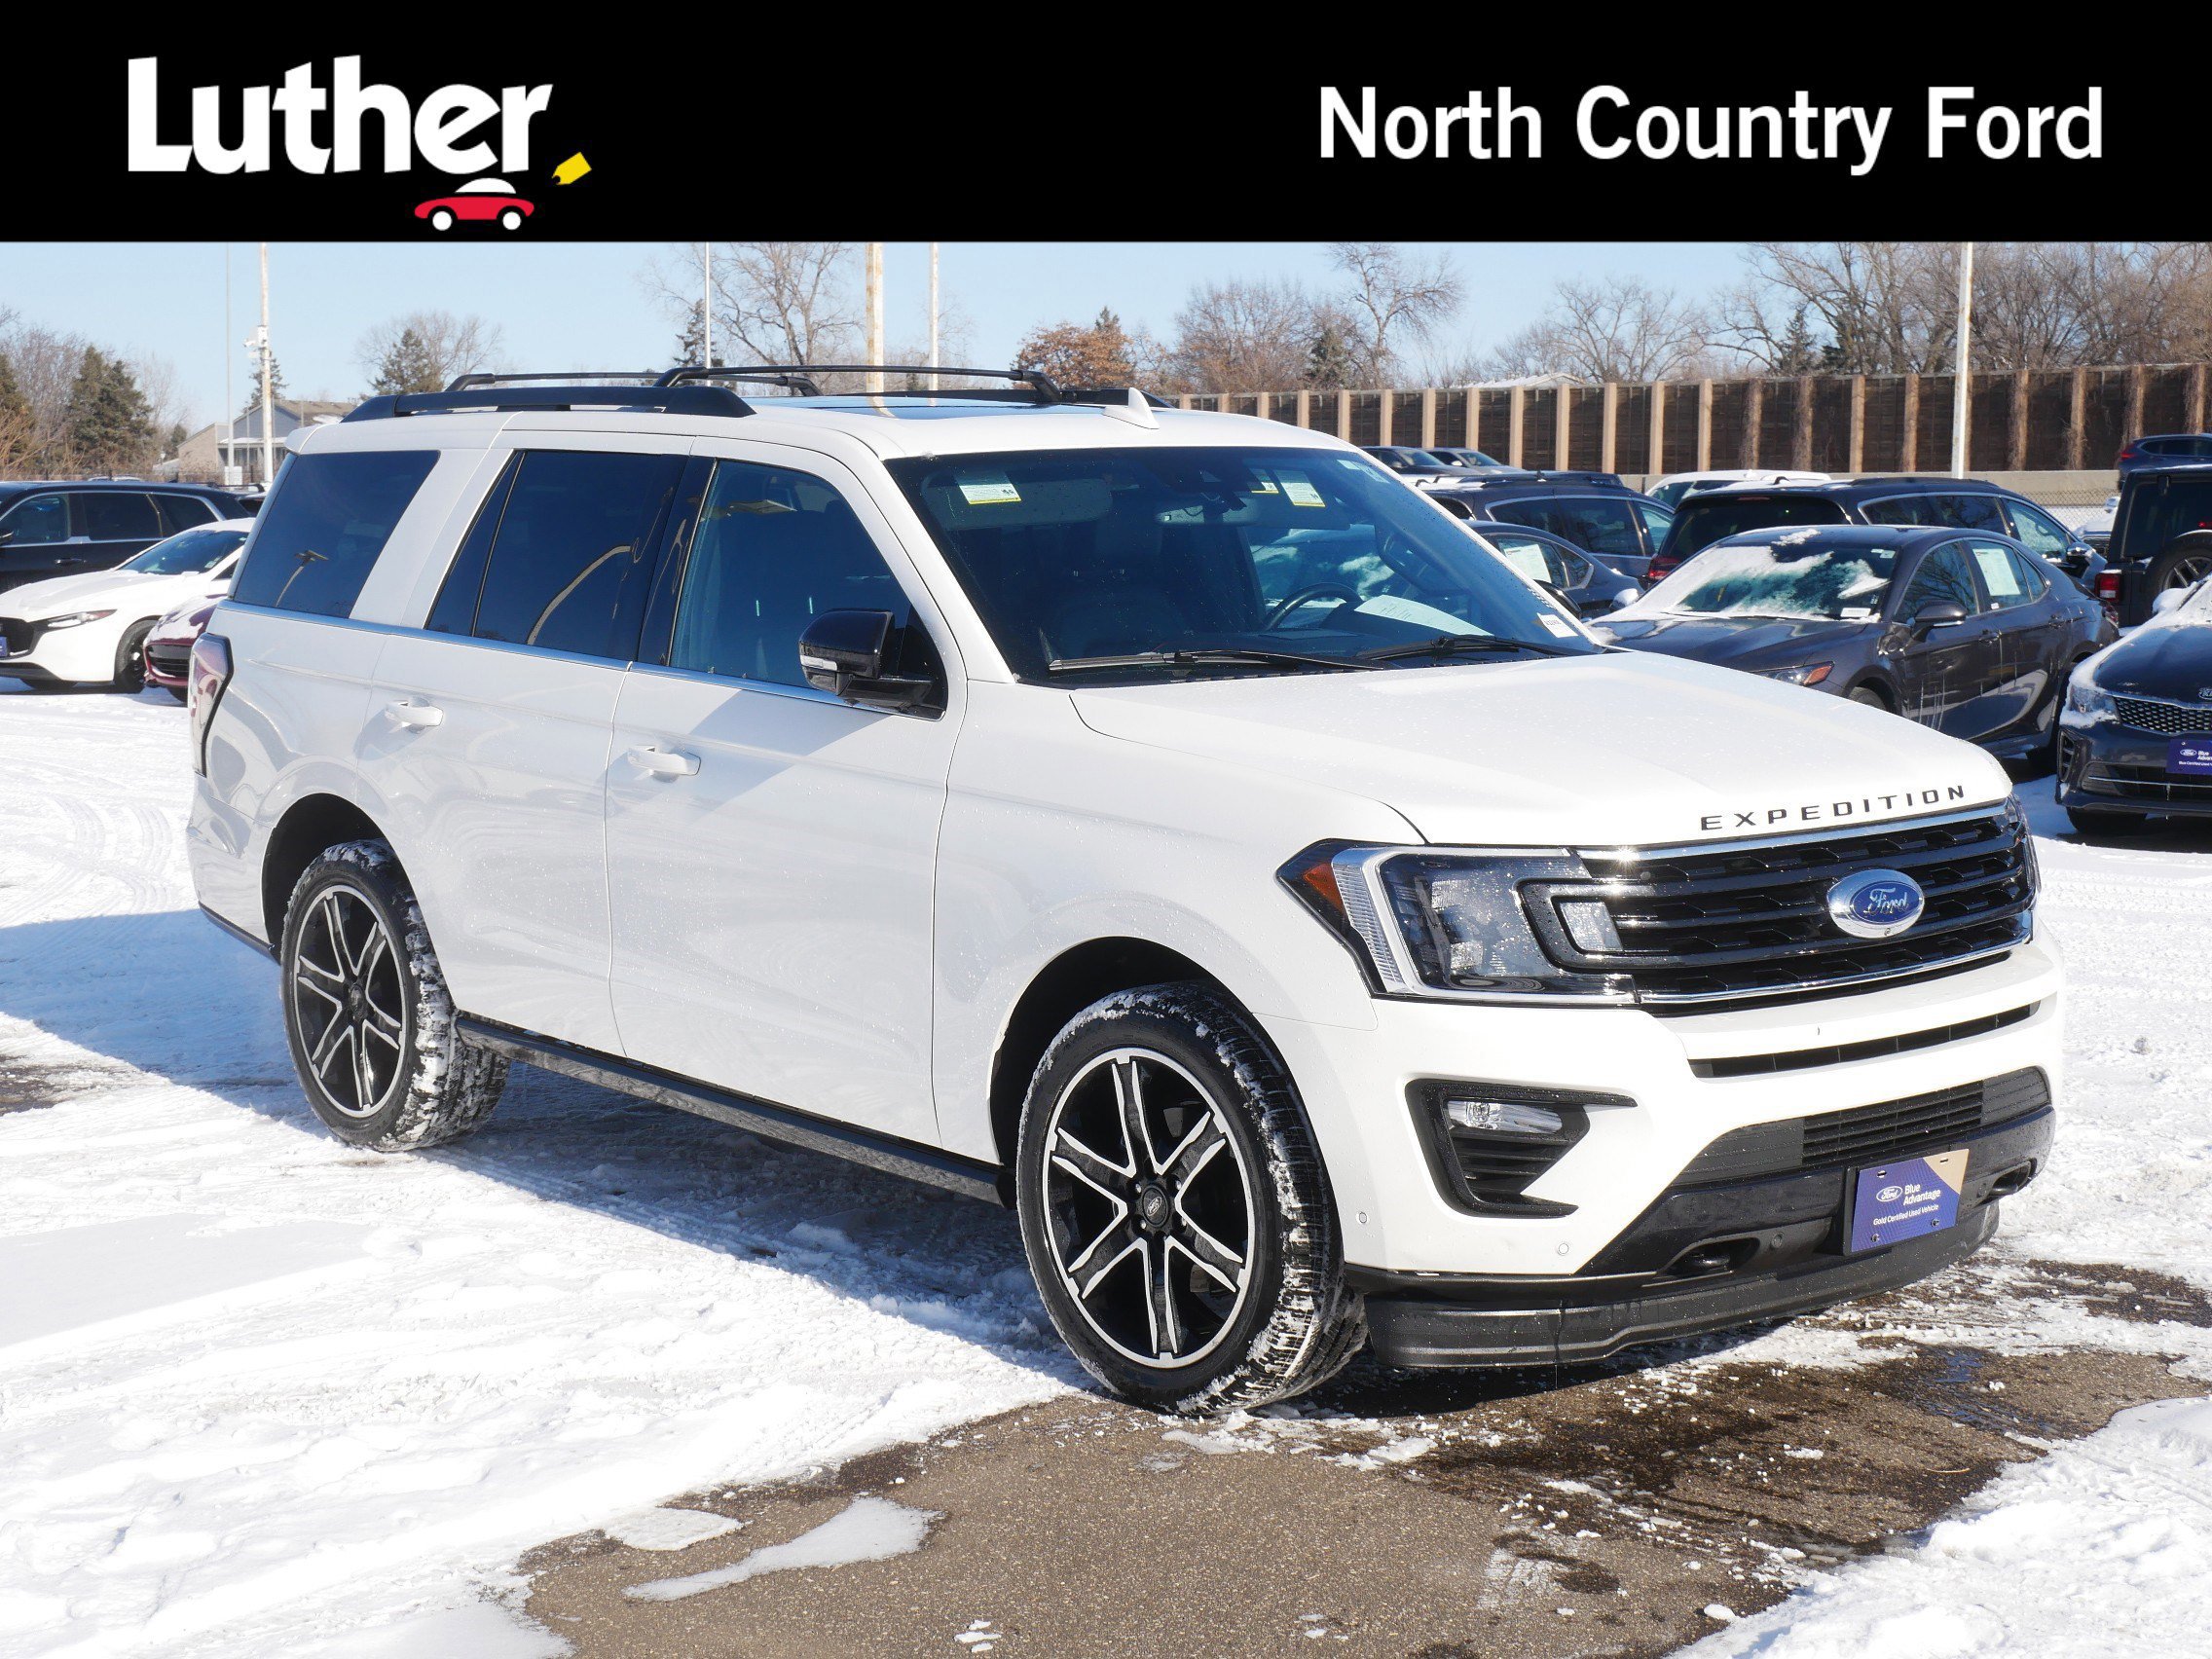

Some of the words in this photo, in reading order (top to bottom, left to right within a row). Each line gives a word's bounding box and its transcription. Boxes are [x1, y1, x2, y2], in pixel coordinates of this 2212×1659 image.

[1701, 786, 1965, 831] EXPEDITION
[1863, 887, 1908, 914] Ford
[1881, 1189, 1899, 1200] Ford
[1902, 1189, 1941, 1205] Advantage
[1904, 1184, 1920, 1195] Blue
[1873, 1216, 1887, 1226] Gold
[1887, 1211, 1908, 1222] Certified
[1908, 1207, 1921, 1218] Used
[1921, 1203, 1939, 1214] Vehicle
